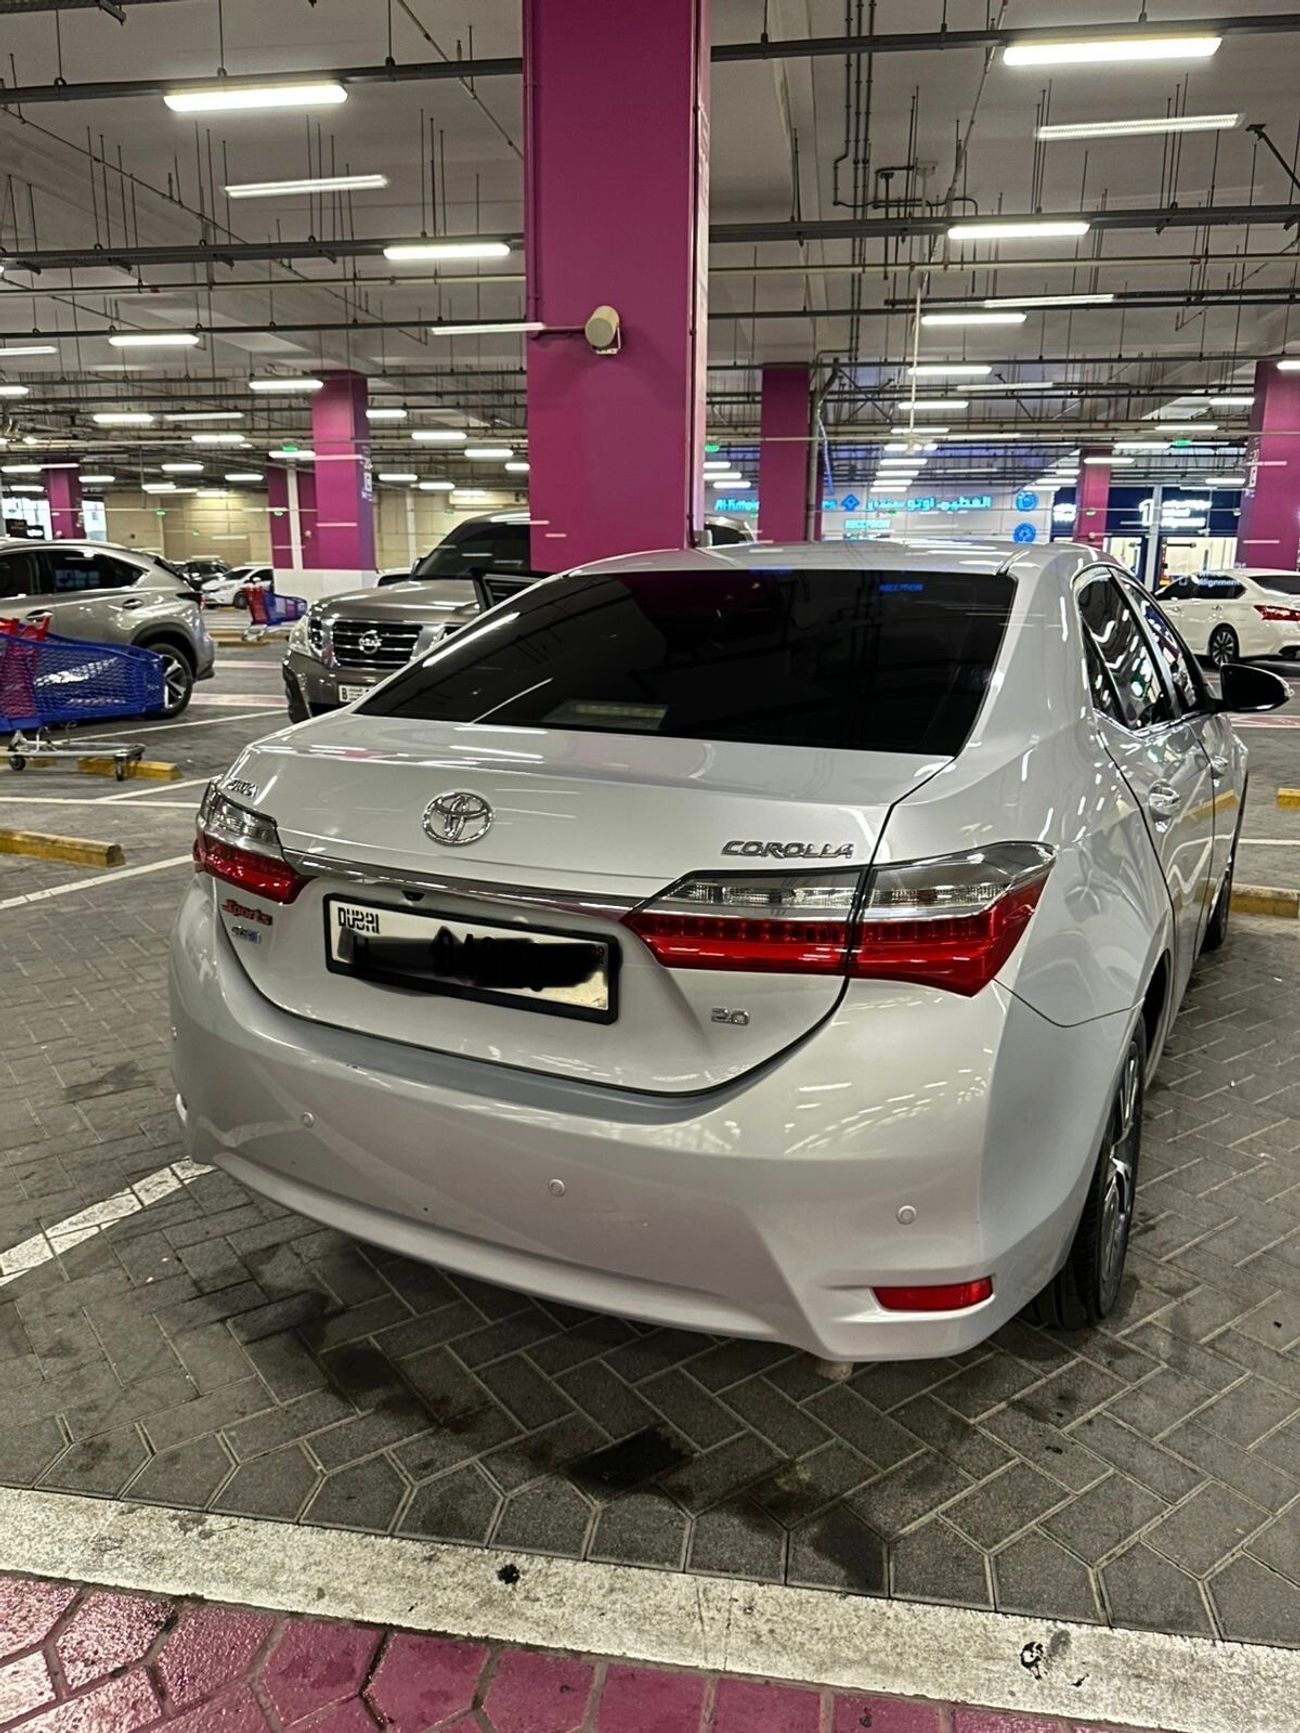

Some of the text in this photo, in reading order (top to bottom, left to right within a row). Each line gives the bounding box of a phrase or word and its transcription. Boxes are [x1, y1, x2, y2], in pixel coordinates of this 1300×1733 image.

[721, 840, 854, 859] COROLLA
[337, 906, 380, 935] DUBAI
[711, 1007, 750, 1026] 2.0
